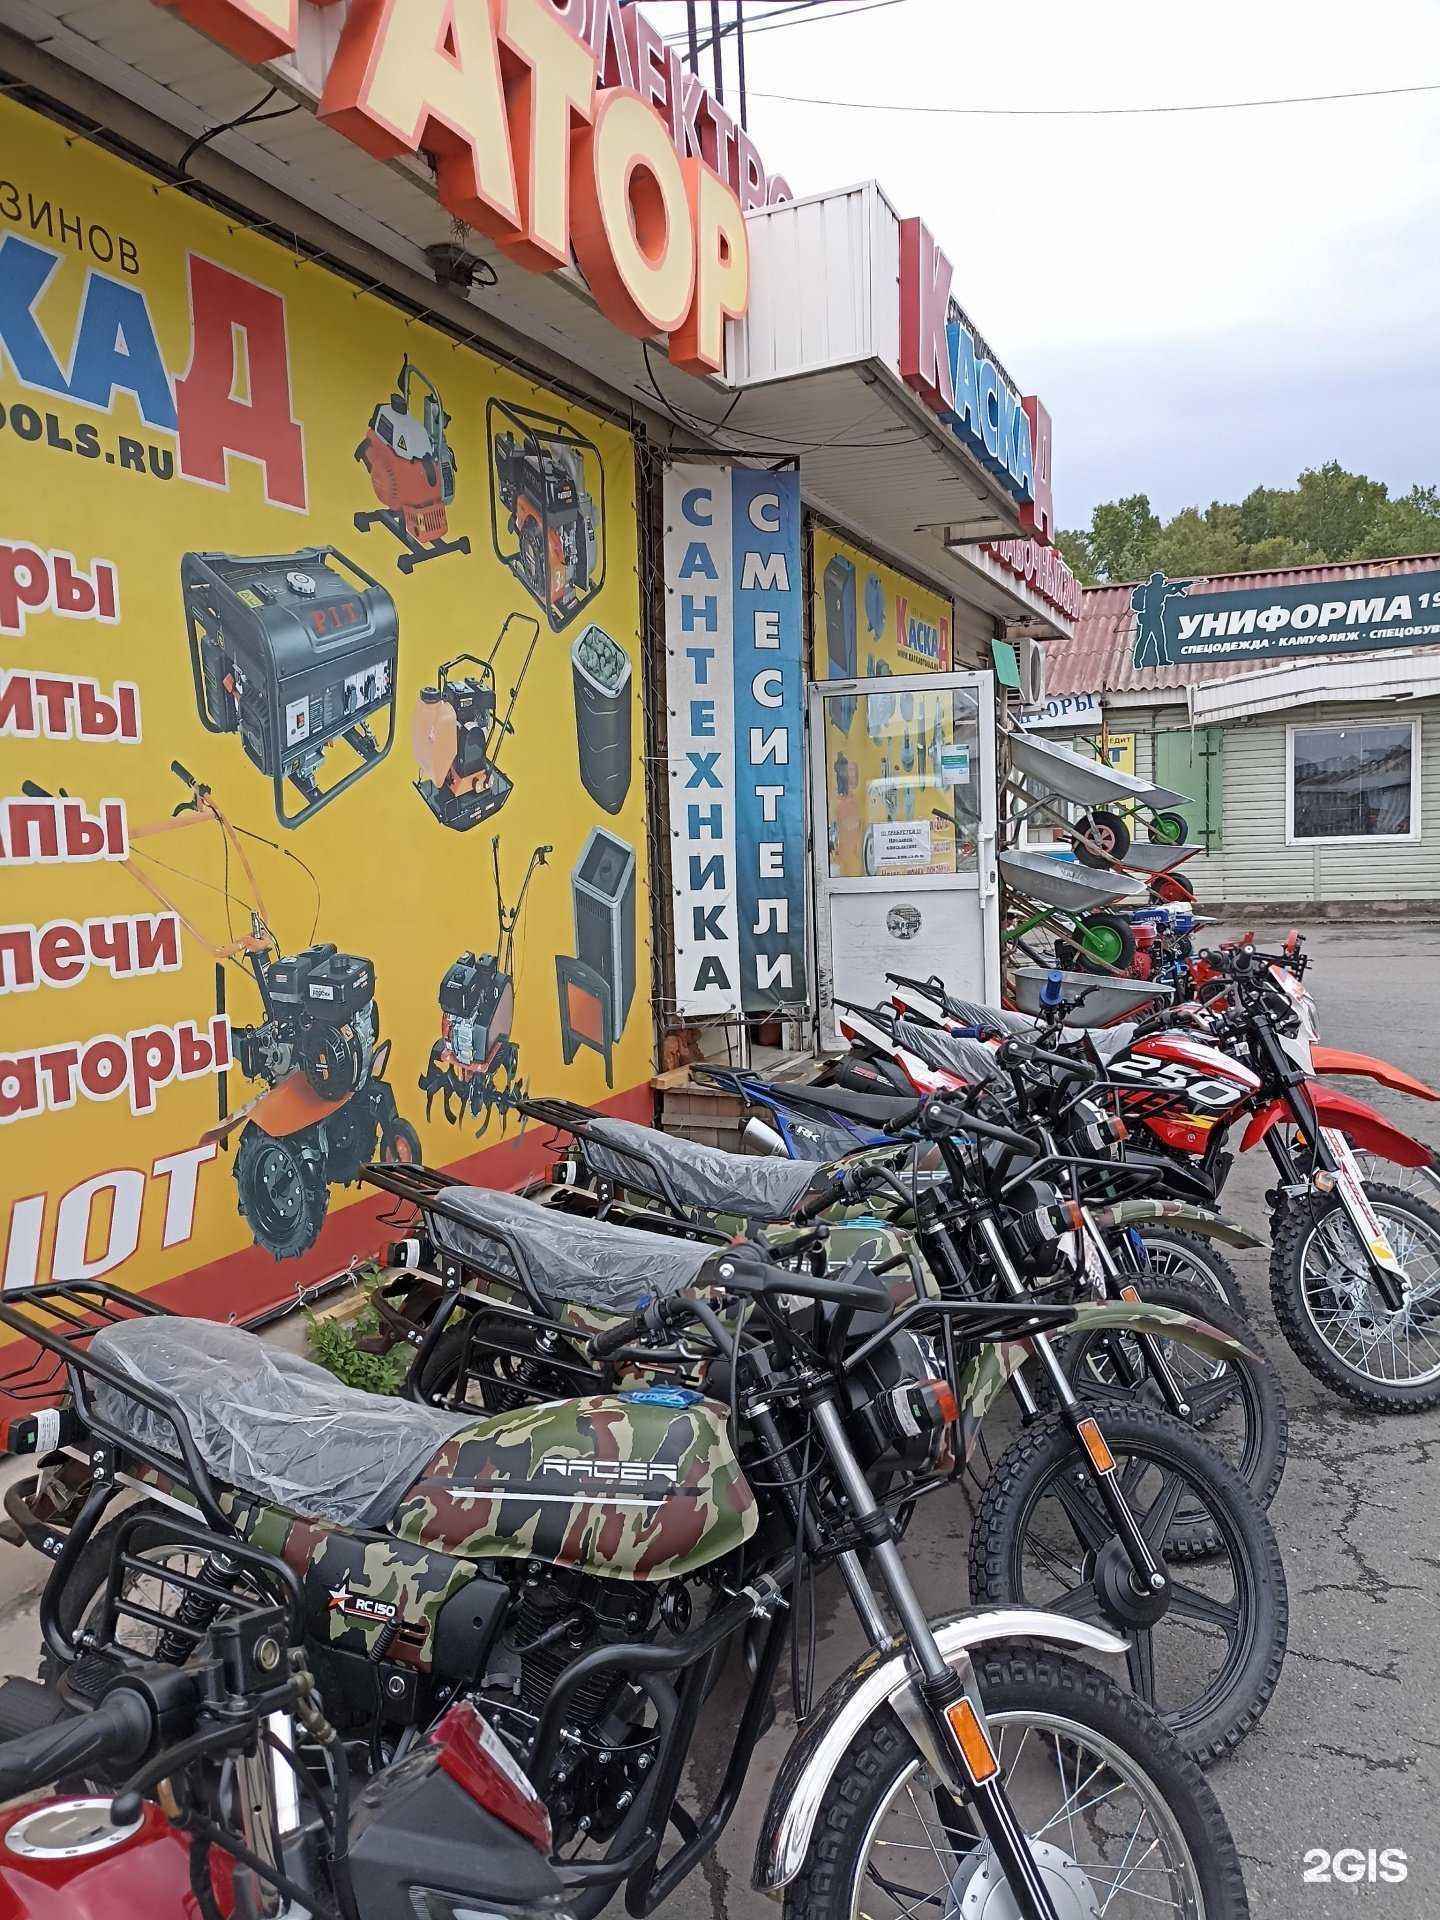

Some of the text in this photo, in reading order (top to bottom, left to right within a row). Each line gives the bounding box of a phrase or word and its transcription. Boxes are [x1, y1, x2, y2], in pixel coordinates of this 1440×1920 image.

[548, 0, 794, 211] ЛЕКТР
[180, 0, 748, 372] АТОР
[0, 180, 140, 275] ЗИНОВ
[901, 216, 1055, 546] КАСКАД
[0, 402, 175, 480] OLS.RU
[1177, 595, 1412, 640] УНИФОРМА
[1180, 639, 1269, 655] СПЕЦОДЕЖДА
[1279, 631, 1360, 647] КАМУФЛЯЖ
[679, 488, 731, 991] САНТЕХНИКА
[740, 493, 793, 989] СМЕСИТЕЛИ
[1020, 694, 1094, 724] ОРЫ
[0, 804, 125, 857] пы
[1106, 1053, 1241, 1105] 250
[542, 1458, 678, 1482] RACER
[355, 1598, 396, 1617] RC 150
